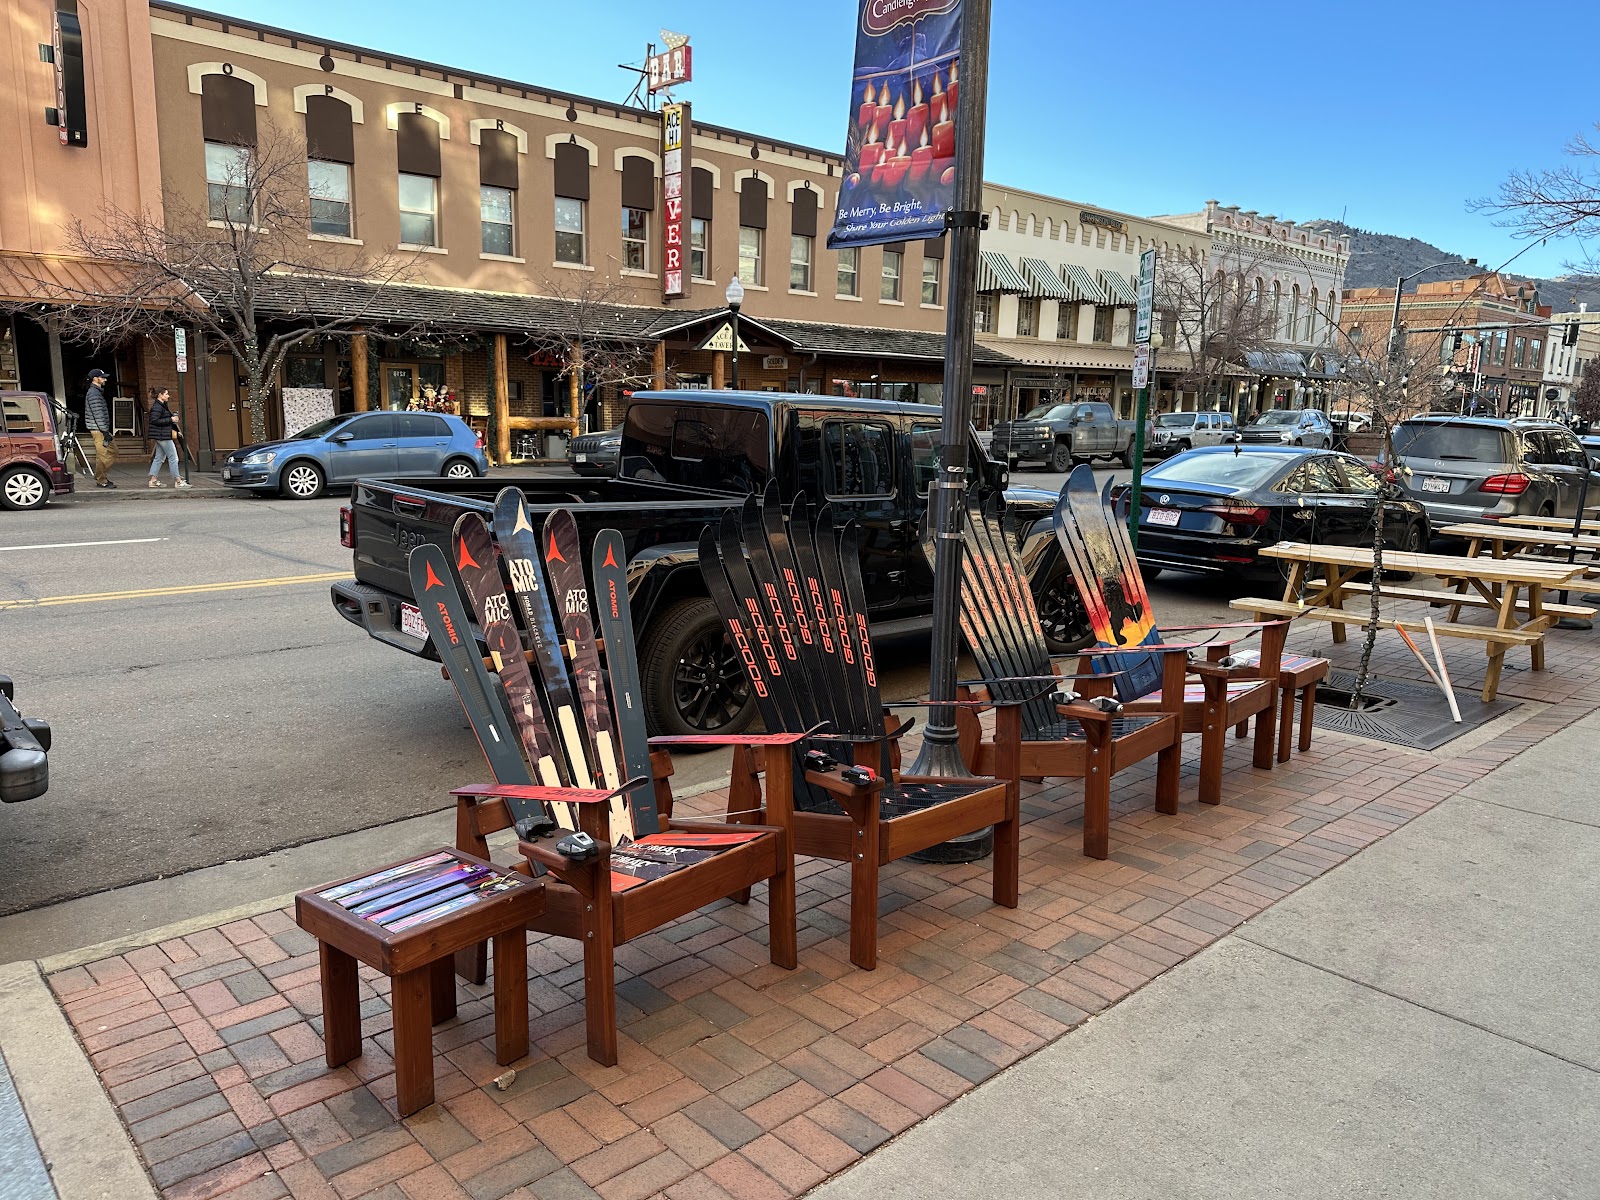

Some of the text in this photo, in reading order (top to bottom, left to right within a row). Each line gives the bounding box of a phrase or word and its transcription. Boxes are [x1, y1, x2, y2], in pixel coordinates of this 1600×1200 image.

[650, 50, 685, 88] BAR
[666, 111, 680, 129] ACE
[668, 129, 678, 146] HI
[838, 199, 923, 220] Be Merry, Be Bright,
[665, 154, 681, 294] AVERN
[844, 212, 945, 233] Share Your Golden Light
[714, 341, 734, 349] TAVE
[716, 333, 728, 342] ACE
[508, 558, 535, 579] ATO
[511, 574, 539, 593] MIC
[484, 593, 508, 610] ATO
[523, 595, 534, 616] NOMAD
[565, 588, 588, 602] ATO
[608, 579, 619, 618] ATOMIC
[484, 606, 510, 624] MIC
[565, 600, 588, 613] MIC
[783, 568, 812, 645] GOODE
[808, 576, 834, 654] GOODE
[436, 602, 459, 645] ATOMIC
[764, 582, 797, 661] GOODE
[831, 588, 854, 665] GOODE
[745, 598, 781, 676] GOODE
[728, 619, 768, 698] GOODE
[856, 612, 877, 687] GOODE
